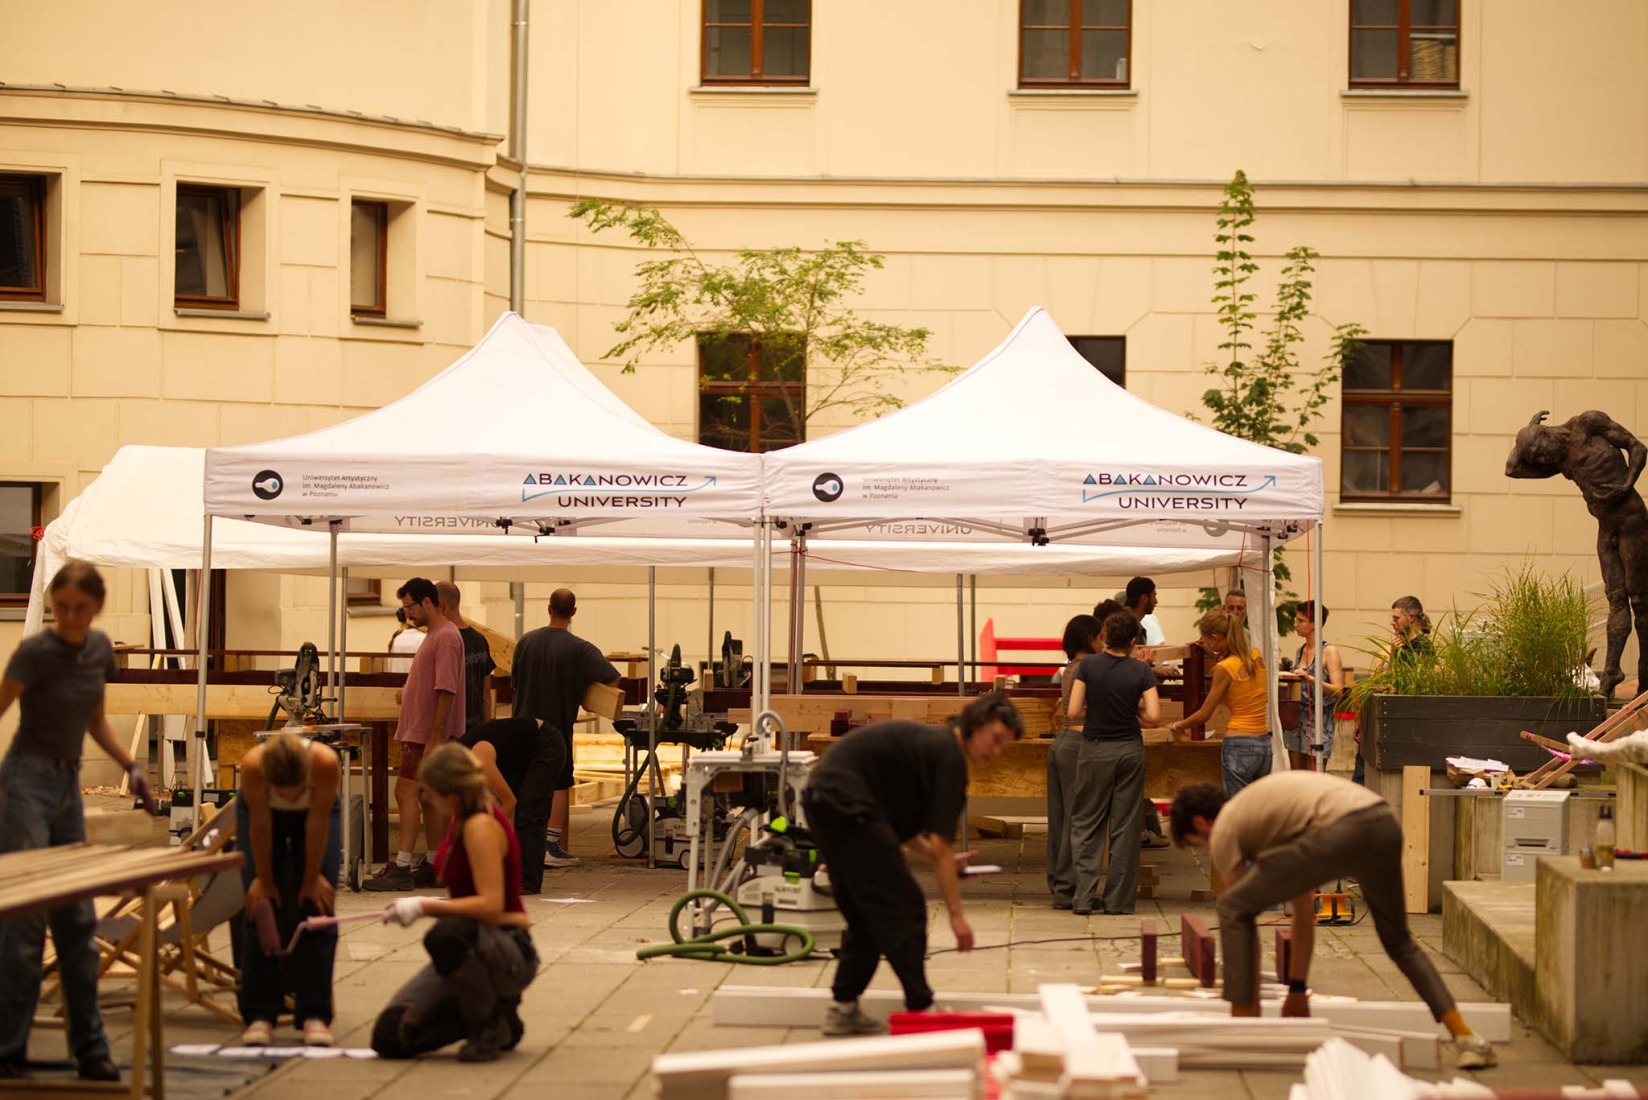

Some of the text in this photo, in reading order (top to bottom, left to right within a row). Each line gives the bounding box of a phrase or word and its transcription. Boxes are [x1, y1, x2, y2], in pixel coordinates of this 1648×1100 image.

[523, 473, 687, 487] ABAKANOWICZ
[1083, 473, 1247, 487] ABAKANOWICZ
[313, 483, 348, 491] Magdaleny
[558, 496, 687, 508] UNIVERSITY
[1118, 497, 1248, 510] UNIVERSITY
